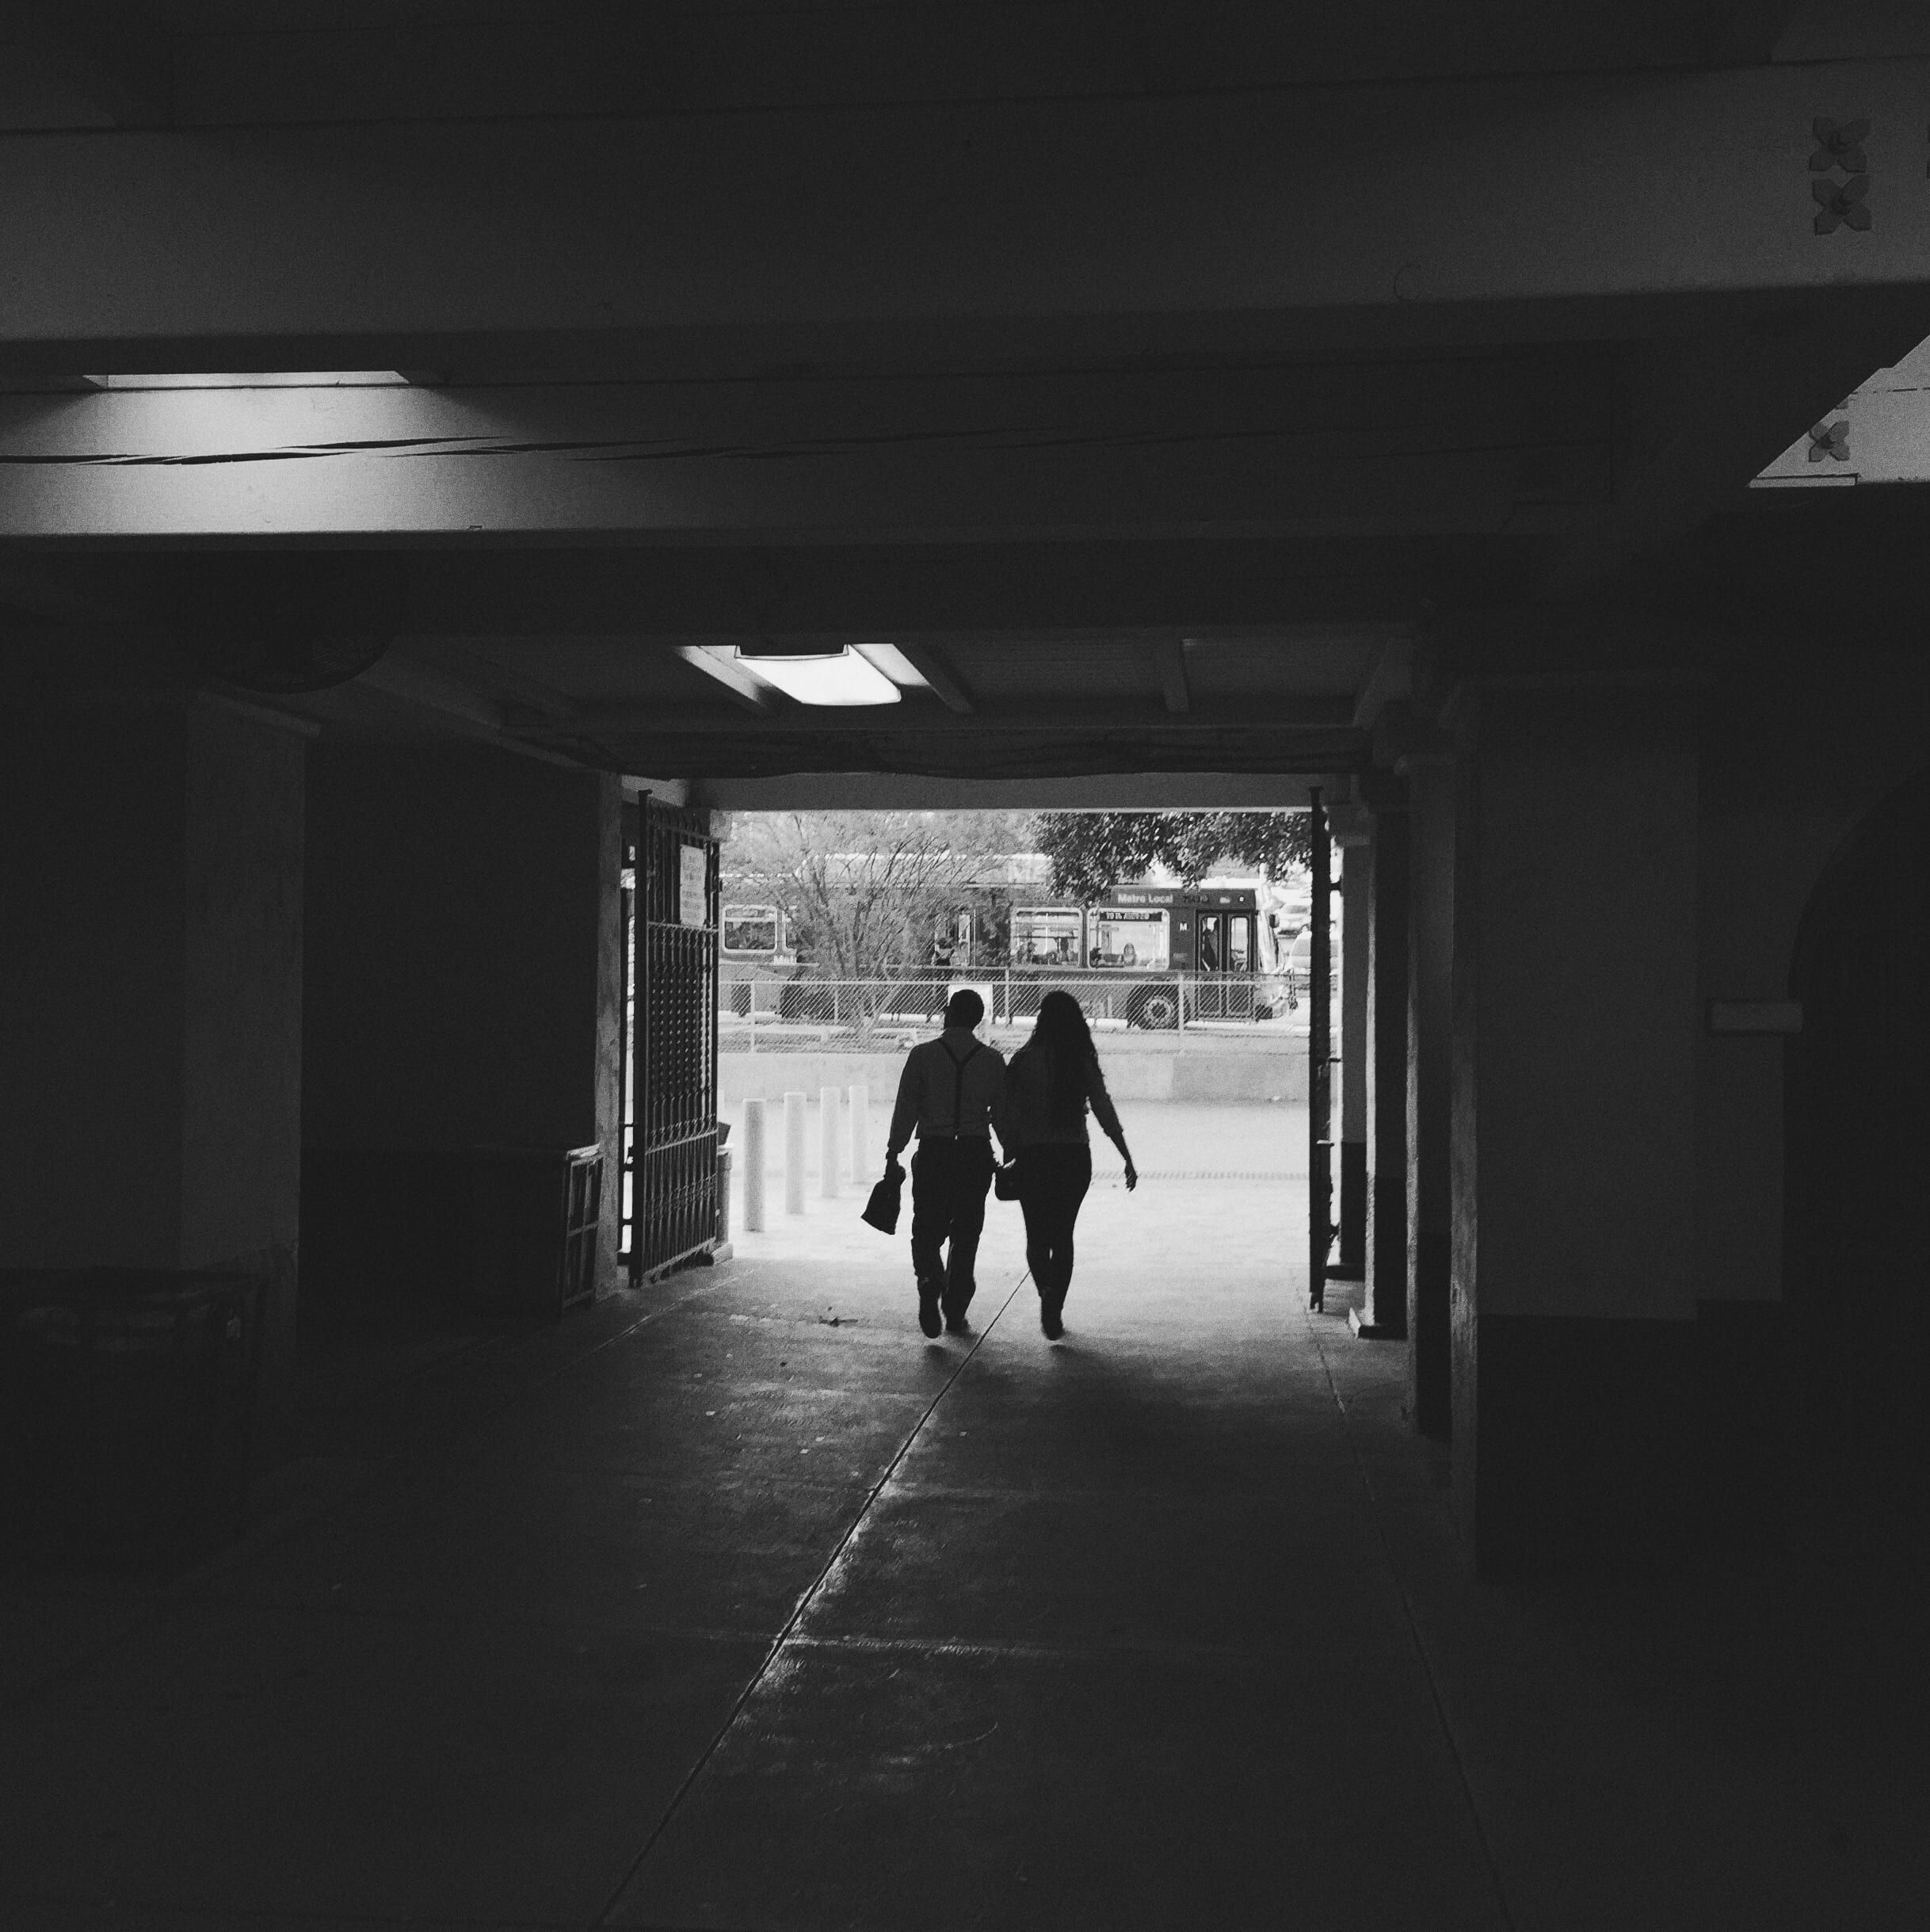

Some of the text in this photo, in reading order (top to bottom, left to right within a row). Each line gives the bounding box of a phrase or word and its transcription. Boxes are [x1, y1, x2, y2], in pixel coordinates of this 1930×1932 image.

[1117, 893, 1146, 903] Metro
[1148, 893, 1173, 903] Local
[1179, 922, 1188, 931] M
[773, 955, 797, 965] Met
